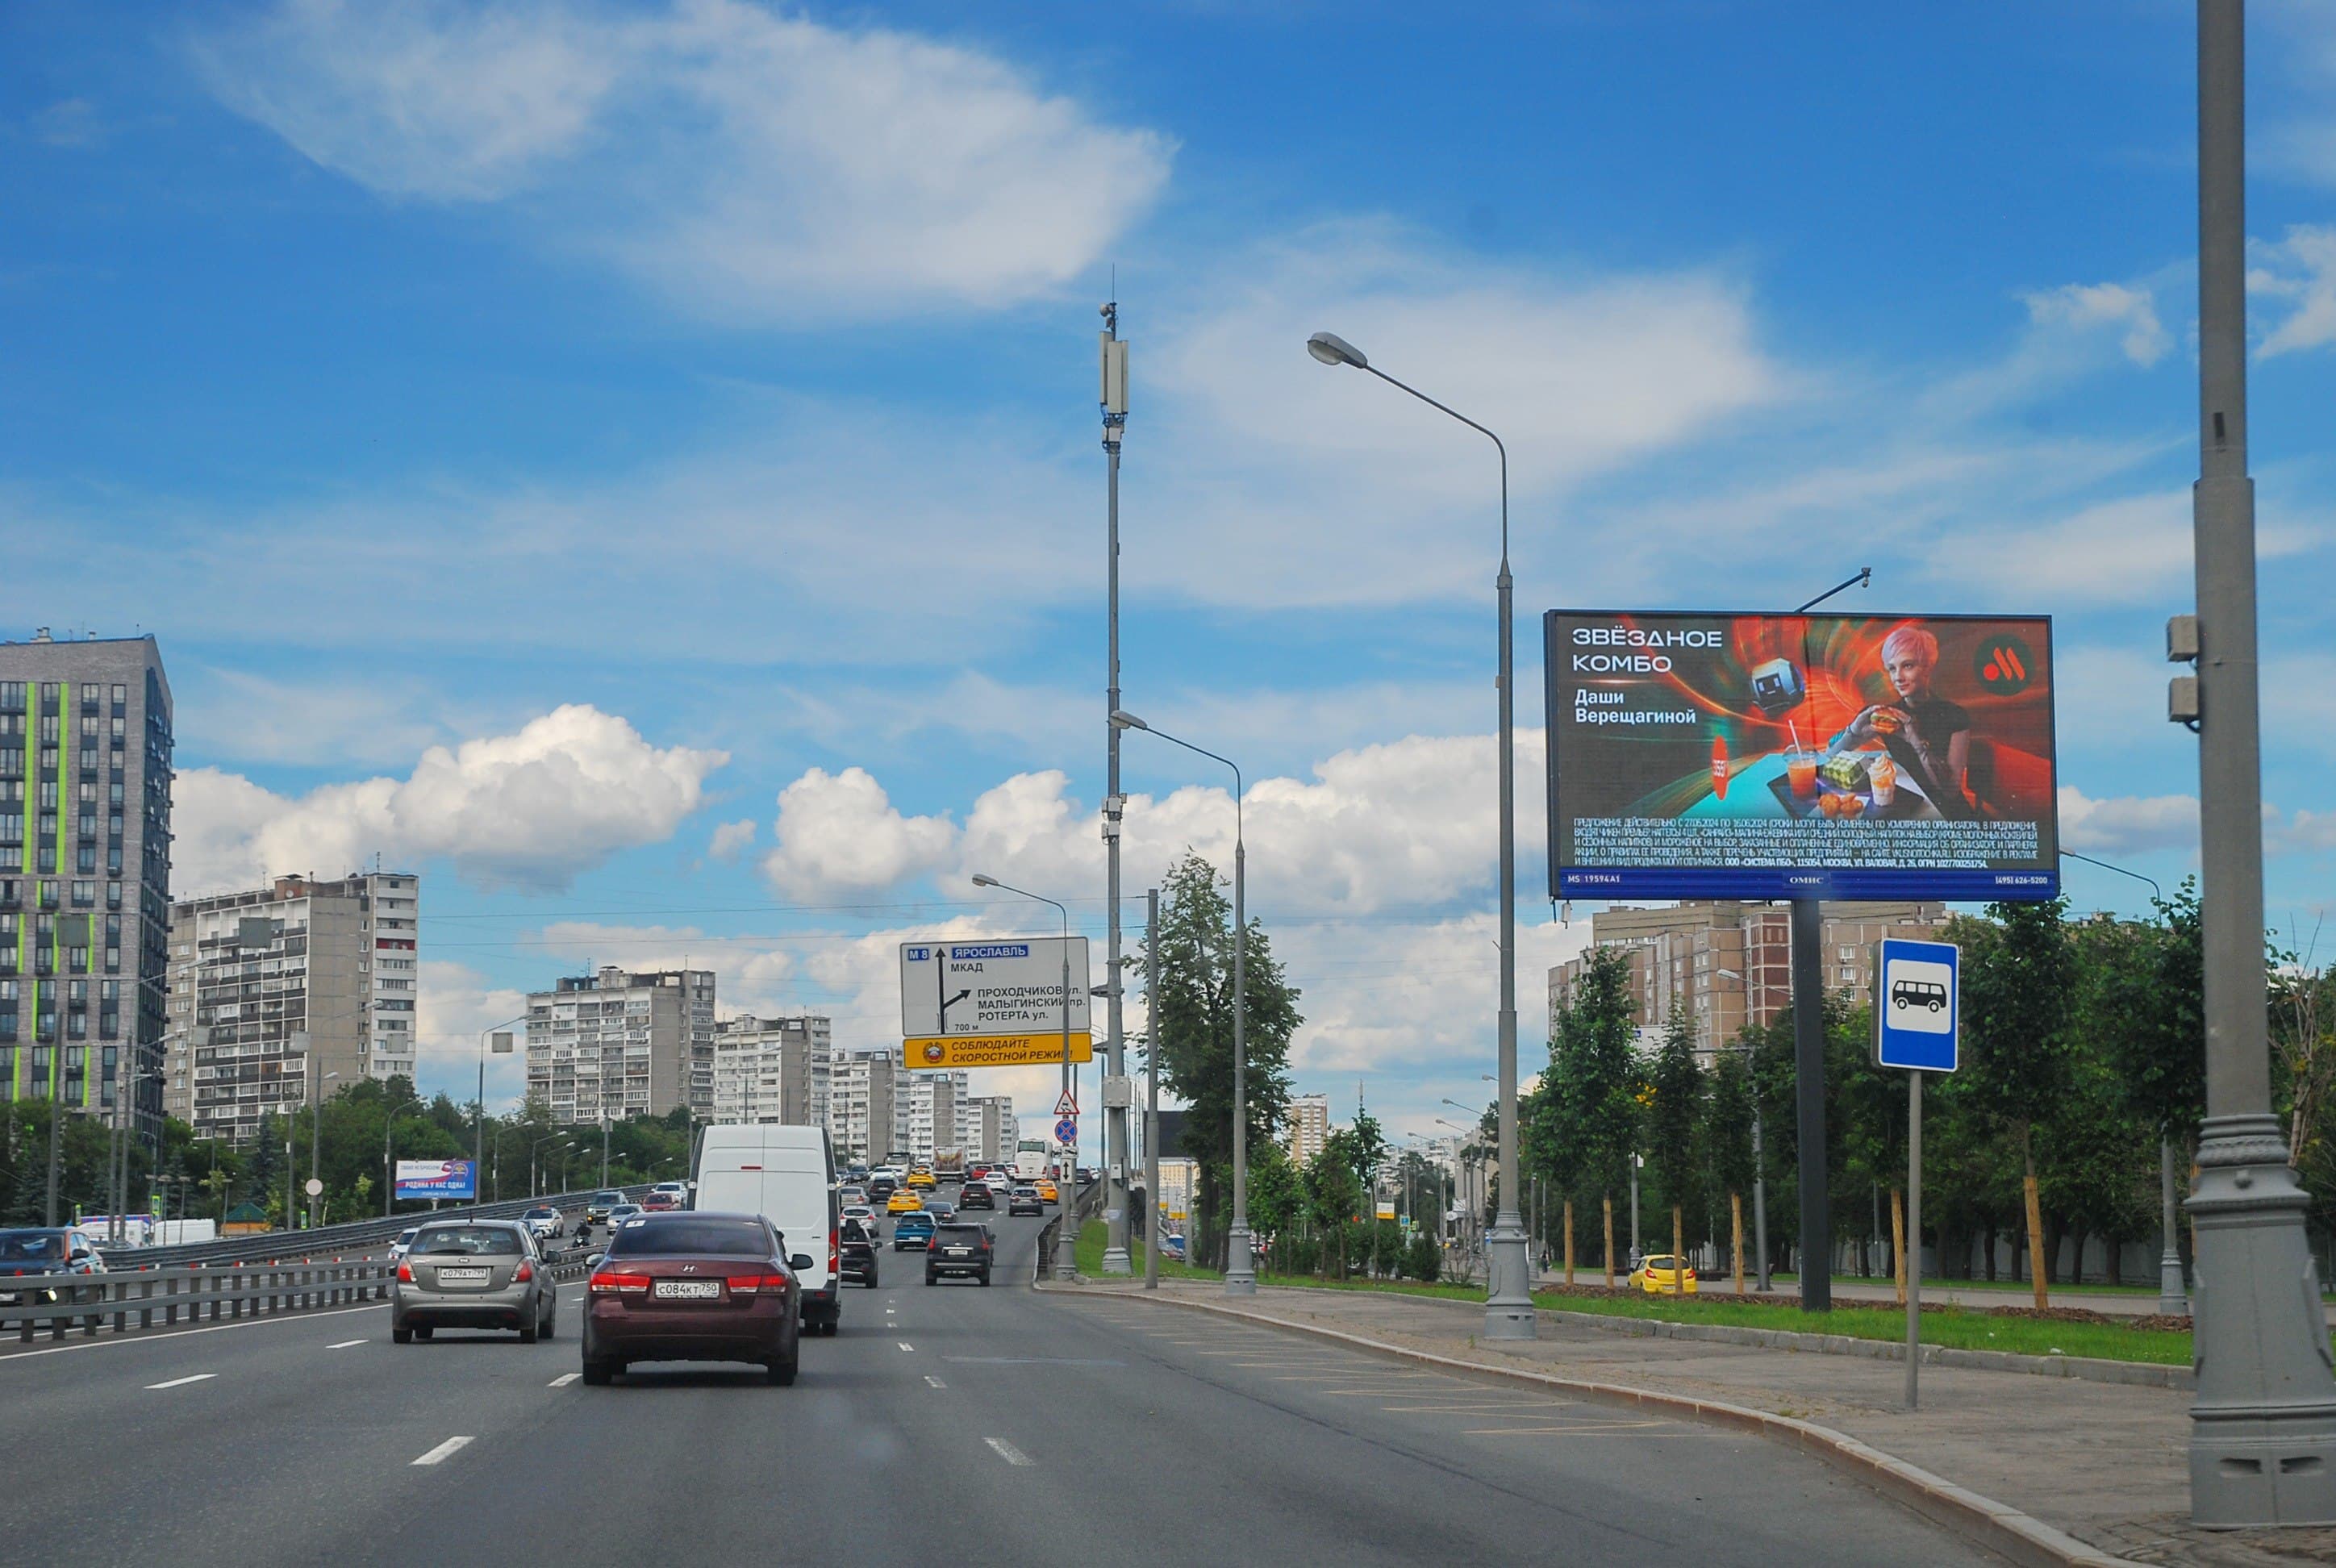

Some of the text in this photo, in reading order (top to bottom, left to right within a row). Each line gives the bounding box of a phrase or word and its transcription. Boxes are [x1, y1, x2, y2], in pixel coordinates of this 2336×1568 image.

[1573, 625, 1723, 647] ЗВЁЗДНОЕ
[1573, 655, 1672, 672] КОМБО
[1575, 689, 1624, 706] Даши
[1575, 708, 1696, 725] Верещагиной
[909, 950, 927, 959] М 8
[955, 947, 1026, 958] ЯРОСЛАВЛЬ
[951, 963, 983, 972] МКАД
[978, 986, 1062, 997] ПРОХОДЧИКОВ
[978, 996, 1085, 1009] МАЛЫГИНСКИЙ пр.
[978, 1011, 1048, 1021] РОТЕРТА ул.
[952, 1039, 1030, 1050] СОБЛЮДАЙТЕ
[952, 1051, 1026, 1062] СКОРОСТНОЙ
